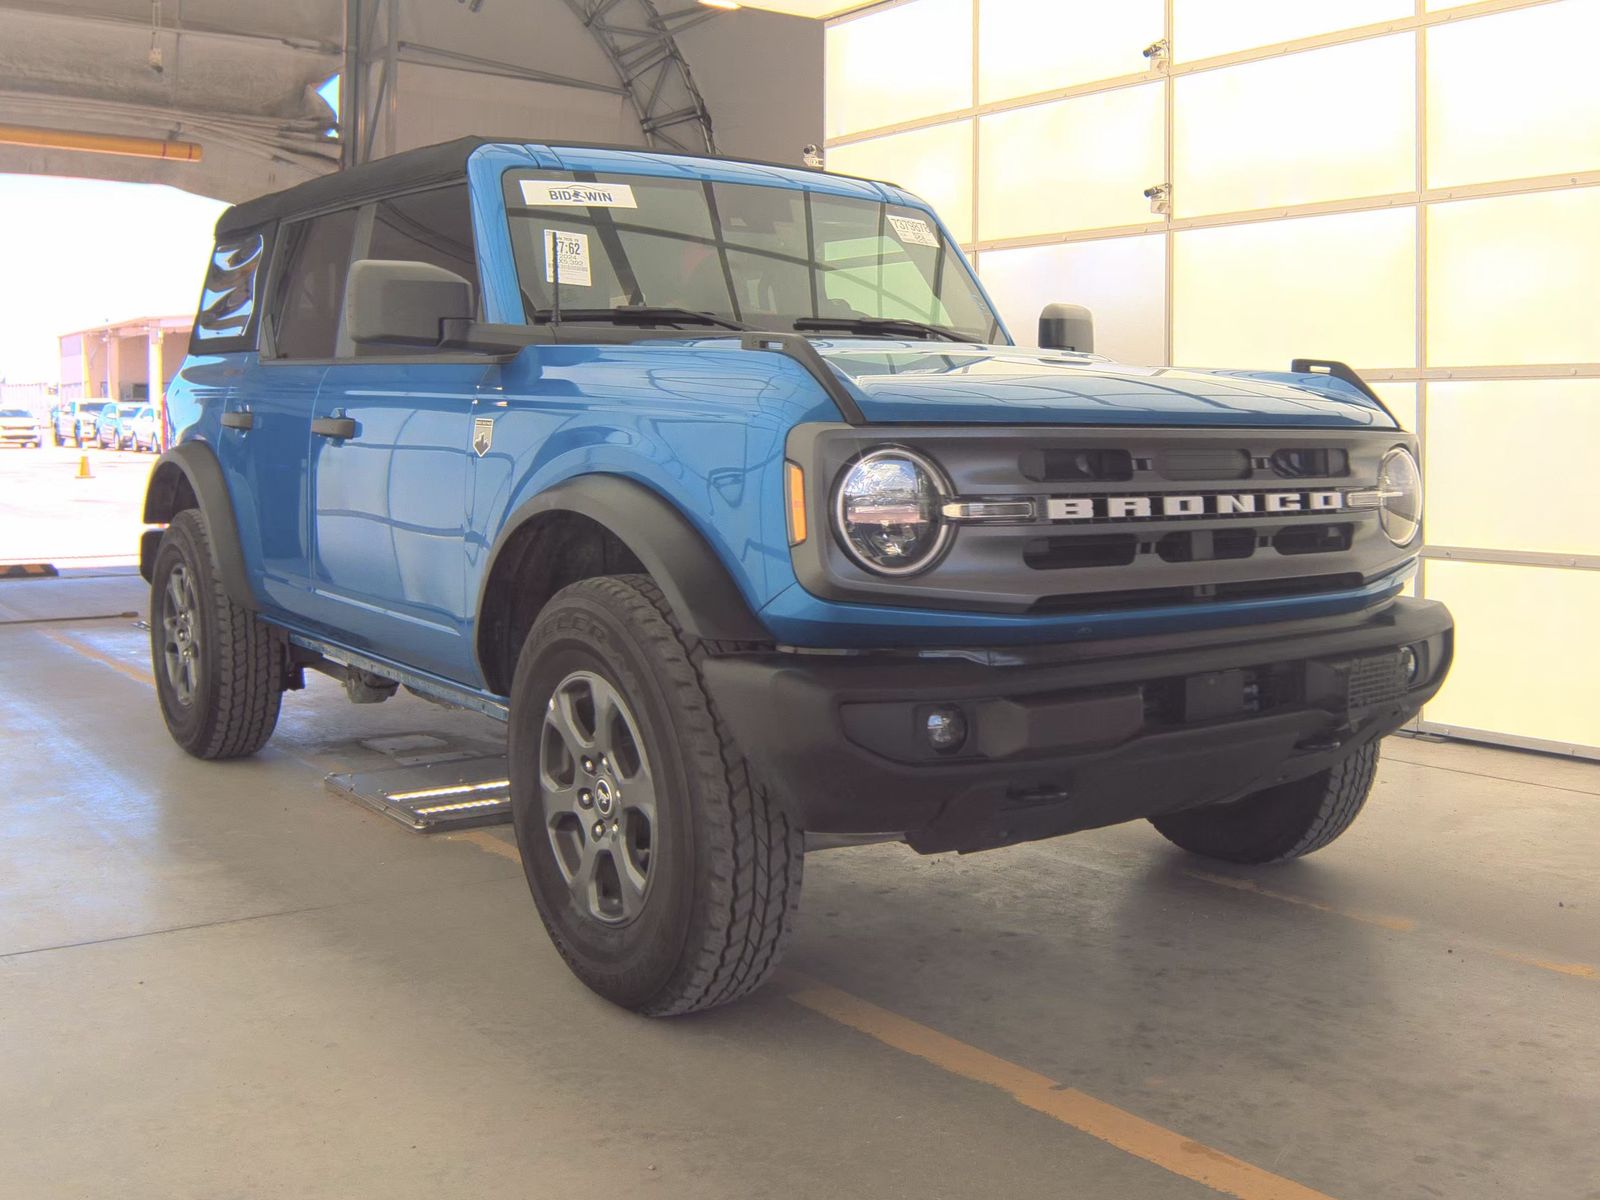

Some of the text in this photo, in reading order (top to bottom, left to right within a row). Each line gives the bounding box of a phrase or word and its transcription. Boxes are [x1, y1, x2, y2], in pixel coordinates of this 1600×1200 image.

[548, 190, 613, 203] BID WIN
[1048, 491, 1342, 519] BRONCO
